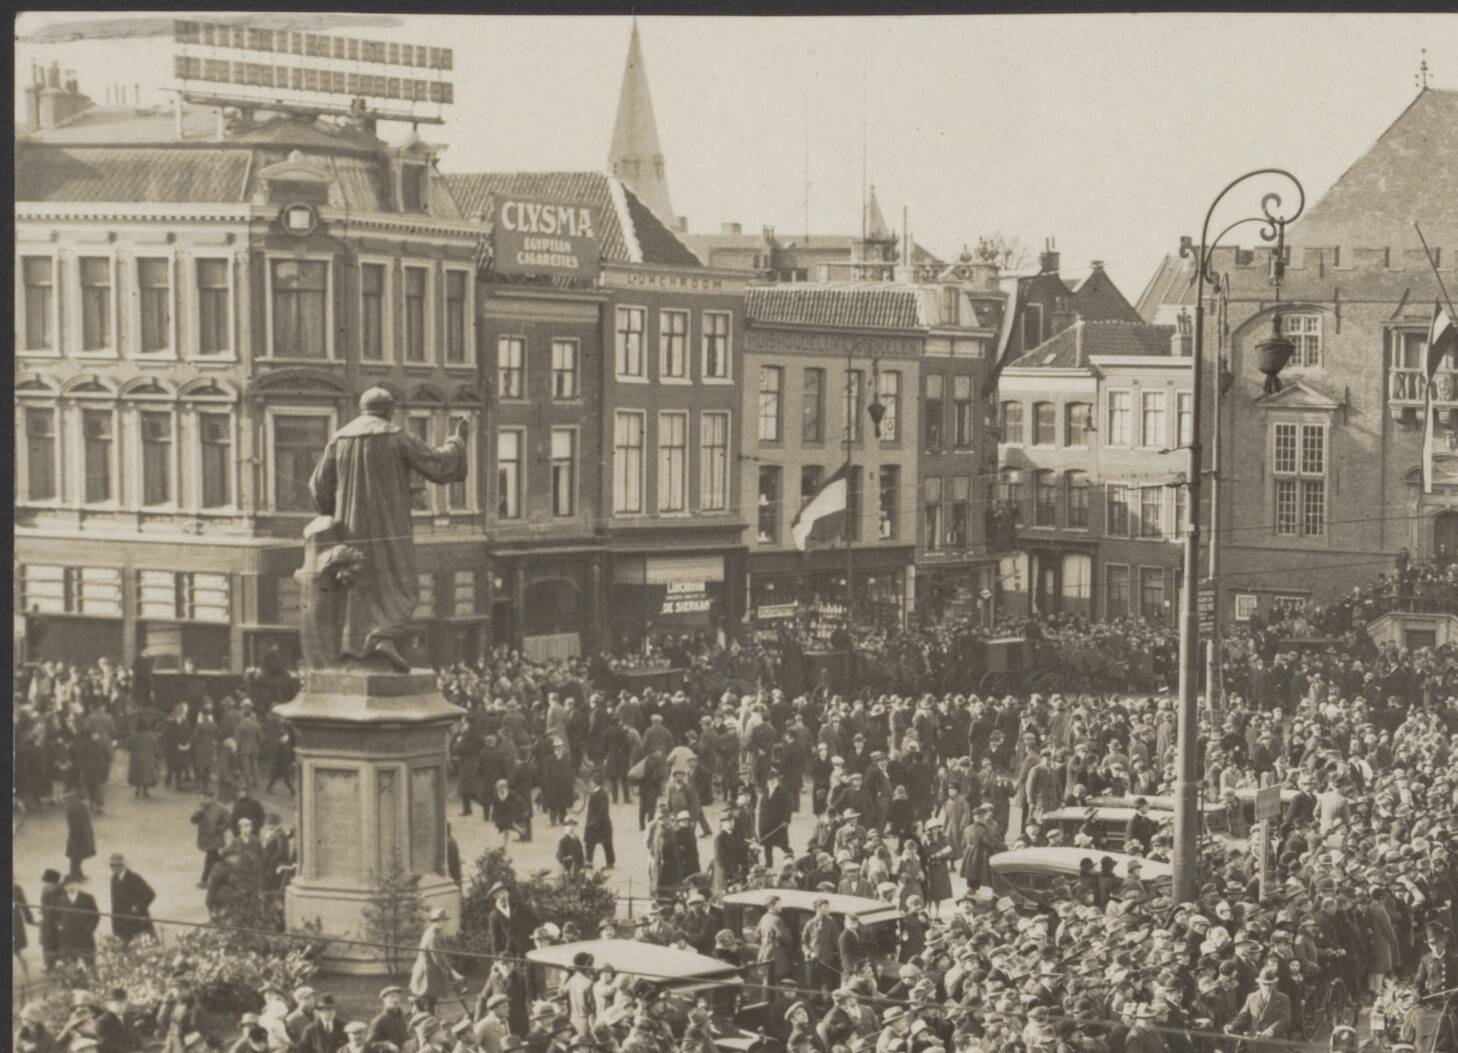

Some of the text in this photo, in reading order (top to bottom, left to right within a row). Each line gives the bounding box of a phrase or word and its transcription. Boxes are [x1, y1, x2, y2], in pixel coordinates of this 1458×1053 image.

[501, 201, 594, 238] CLYSMA
[524, 237, 572, 252] EGYPTIAN
[516, 251, 579, 269] CIGARETTES
[627, 275, 722, 290] LUNCHROOM
